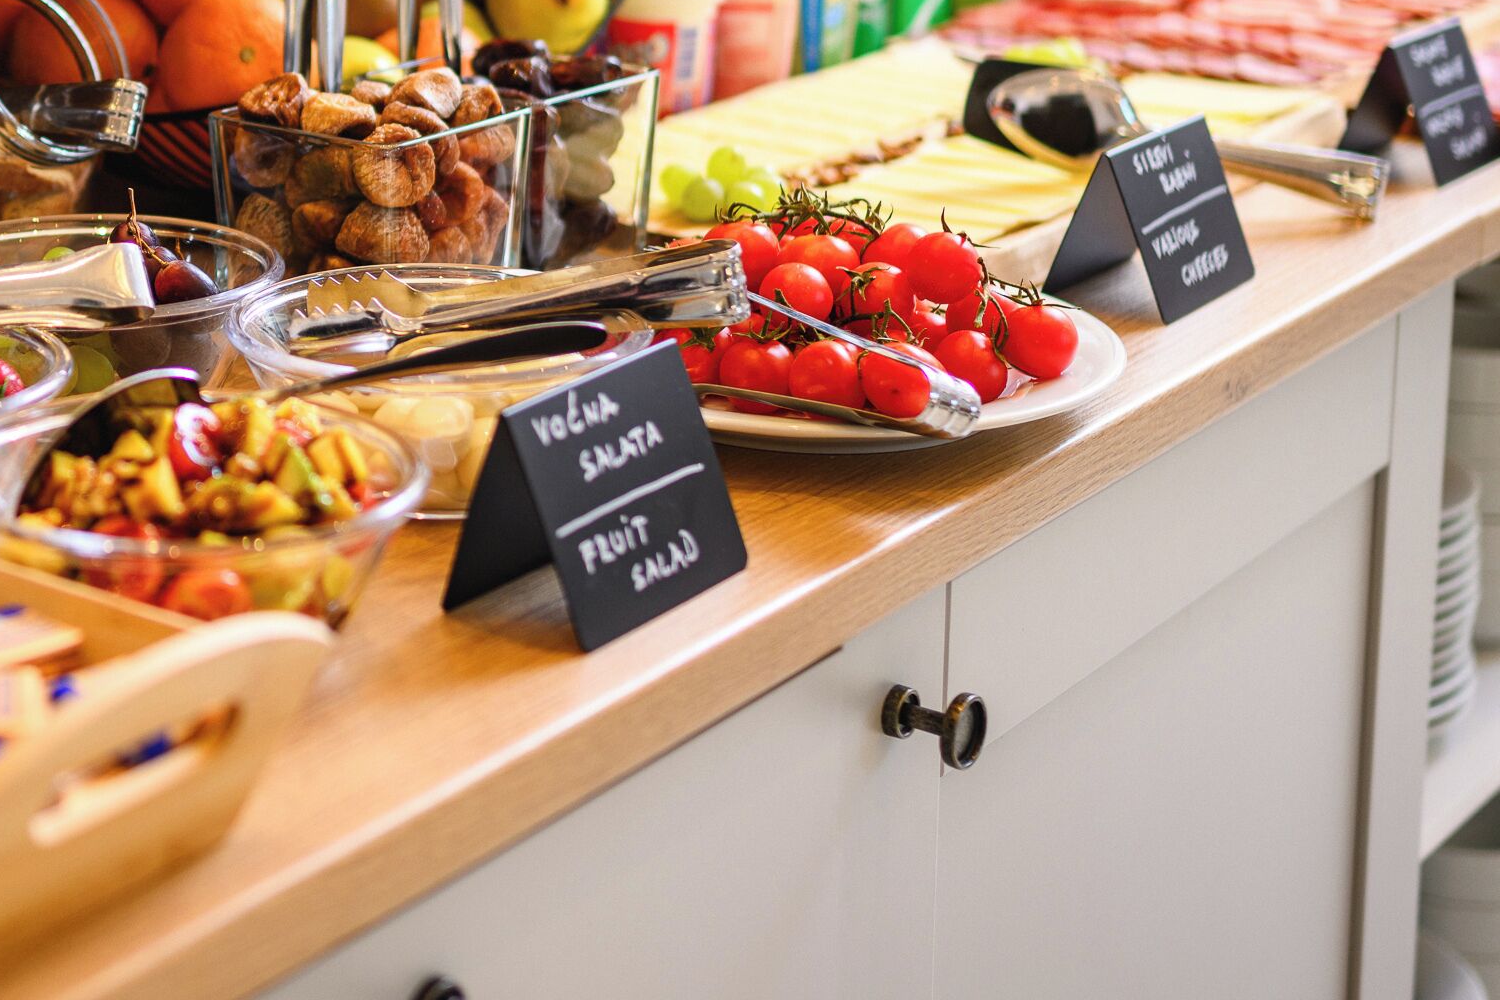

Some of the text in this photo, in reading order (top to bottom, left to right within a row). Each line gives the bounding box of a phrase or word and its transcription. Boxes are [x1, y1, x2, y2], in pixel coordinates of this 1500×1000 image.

[579, 420, 664, 482] SALATA
[578, 514, 649, 575] FRUIT
[630, 528, 701, 593] SALAD
